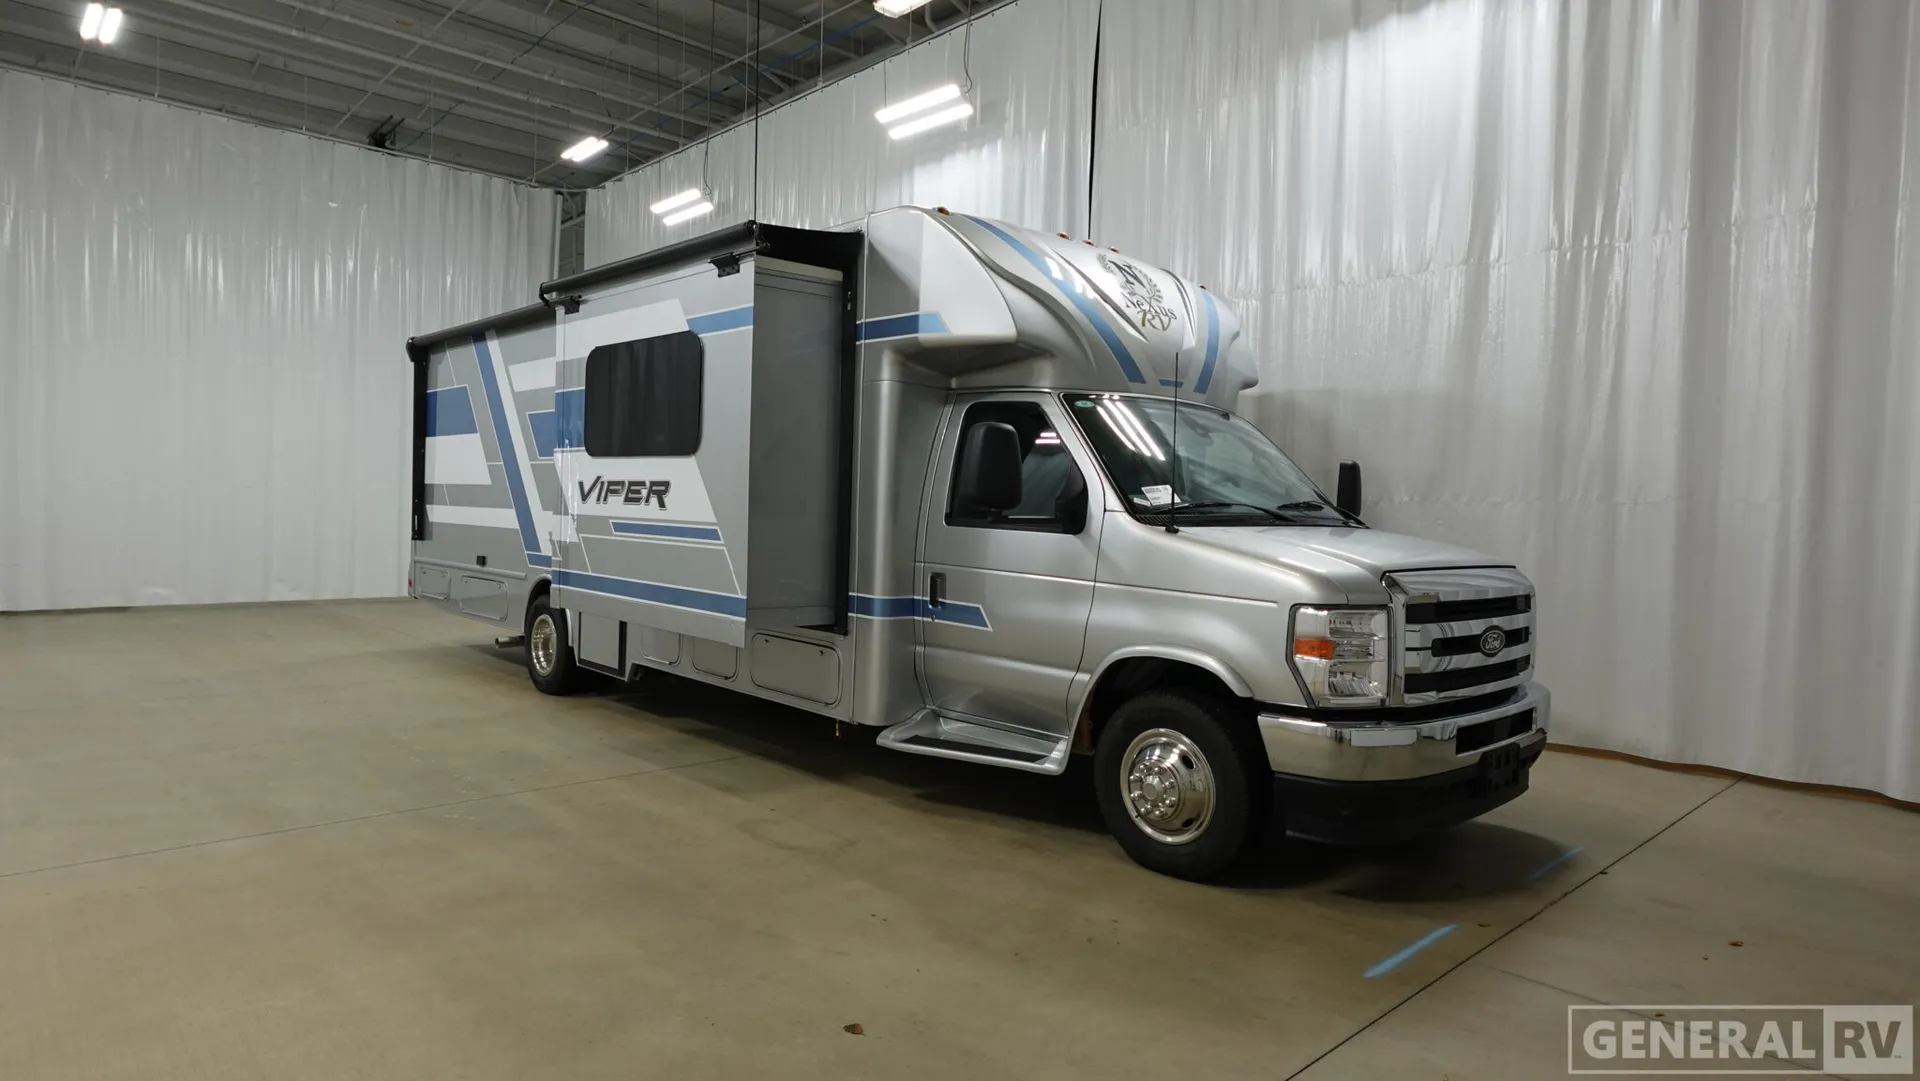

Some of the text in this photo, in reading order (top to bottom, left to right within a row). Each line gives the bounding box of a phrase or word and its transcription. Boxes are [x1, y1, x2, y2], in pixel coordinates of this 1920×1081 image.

[1108, 260, 1148, 289] N
[1137, 309, 1172, 332] RV
[578, 475, 671, 511] VIPER
[1484, 632, 1502, 650] Ford
